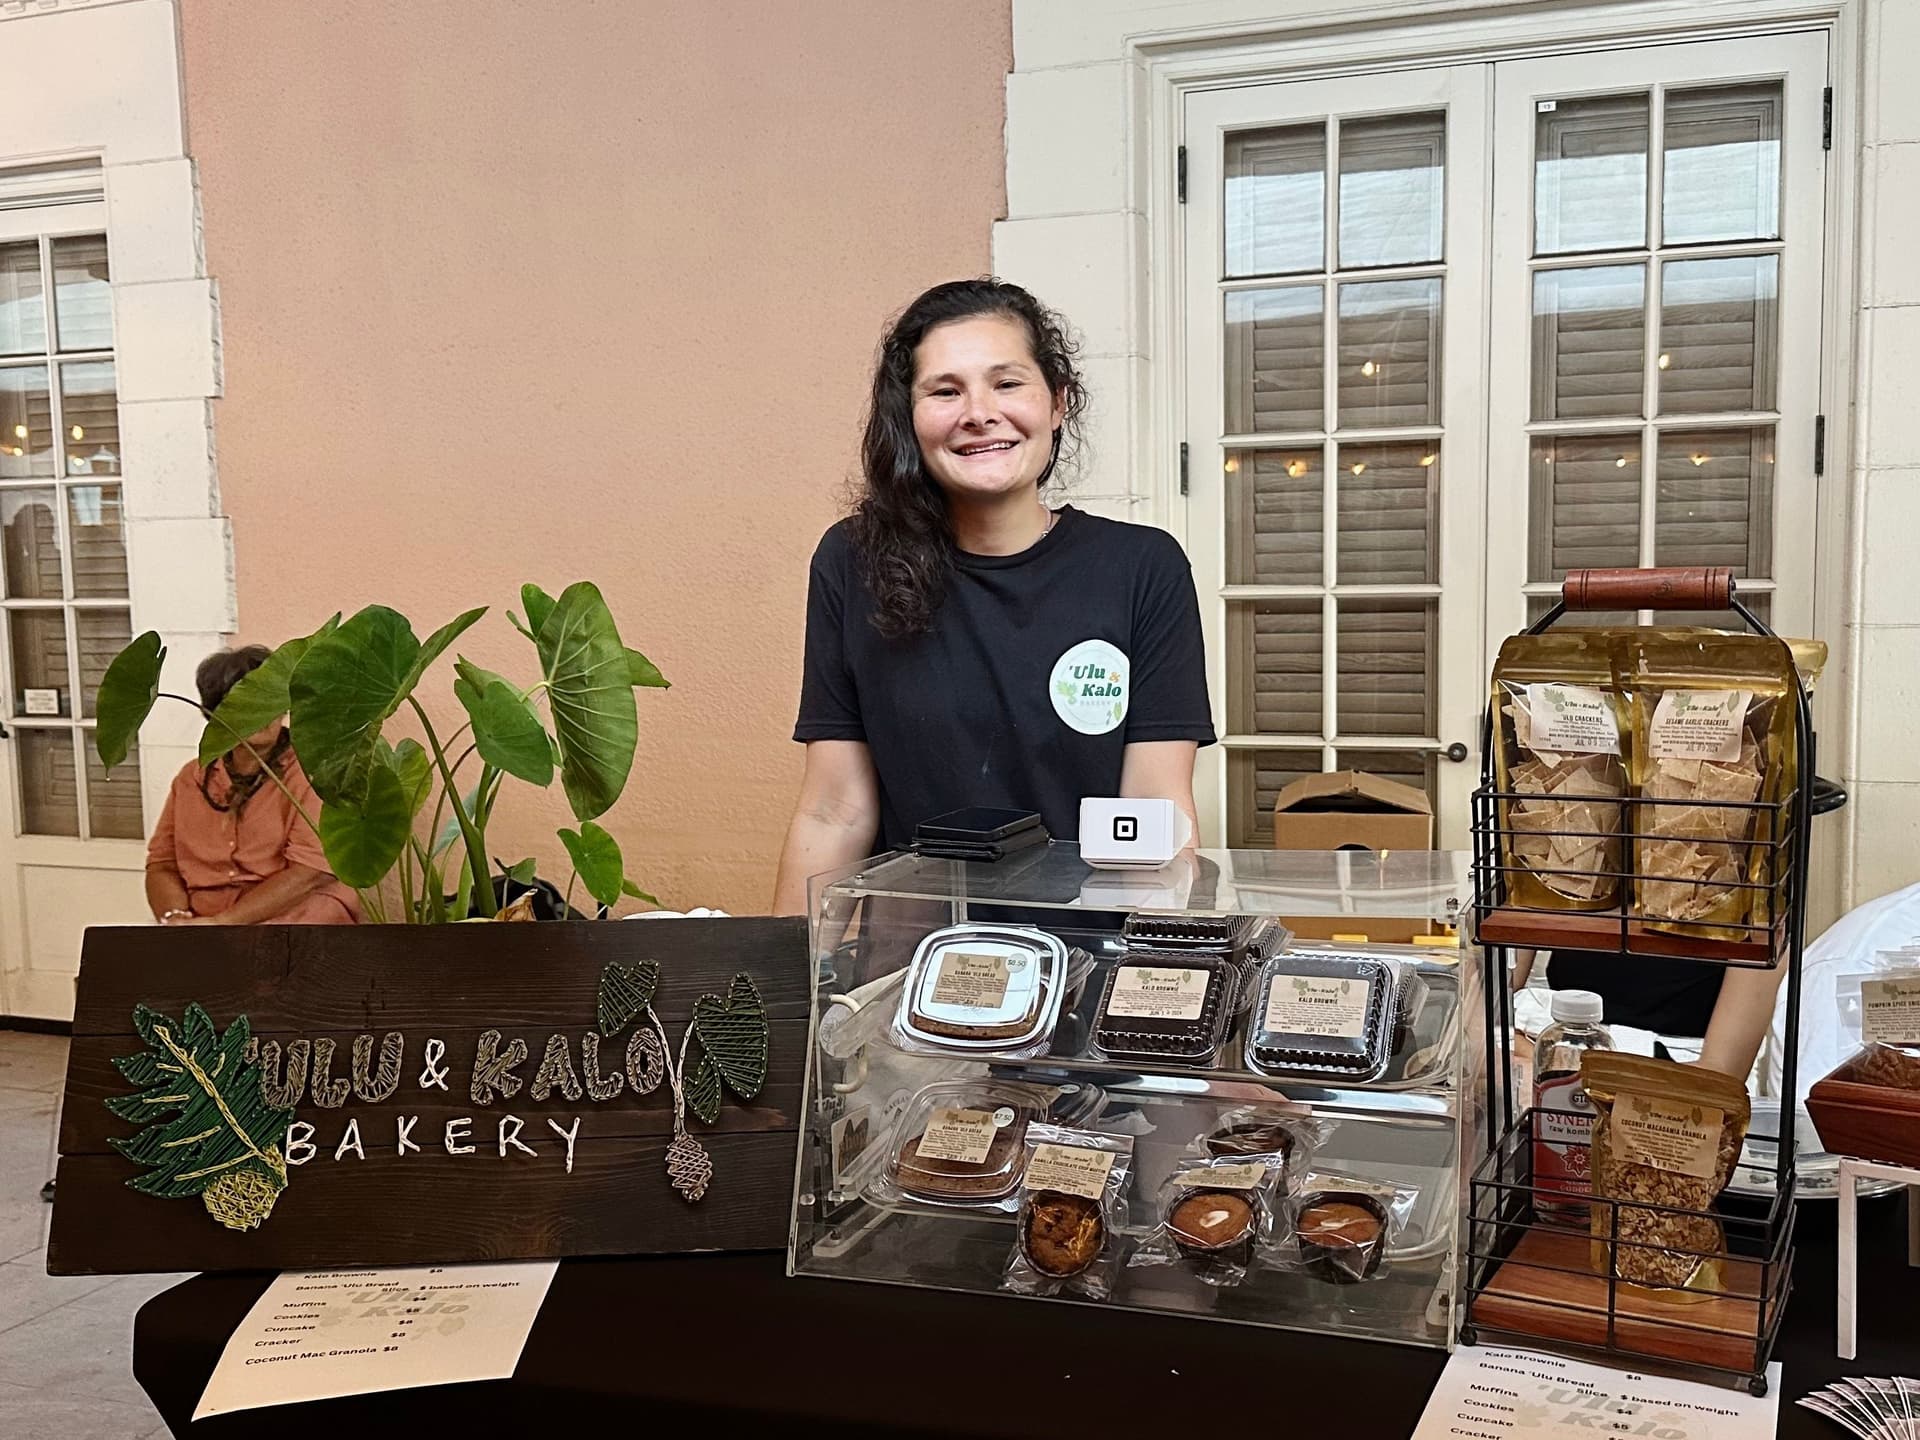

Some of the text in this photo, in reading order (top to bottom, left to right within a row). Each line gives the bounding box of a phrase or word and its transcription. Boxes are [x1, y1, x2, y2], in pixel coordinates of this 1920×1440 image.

[1109, 672, 1120, 683] &
[1081, 683, 1121, 697] Kalo
[1574, 715, 1603, 723] CRACKERS
[1702, 719, 1729, 727] CRACKERS
[419, 1038, 450, 1091] &
[470, 1027, 664, 1105] KALO
[994, 1113, 1013, 1121] $7.50
[1549, 1125, 1564, 1133] raw
[1621, 1119, 1707, 1140] COCONUT MACADAMIA GRANOLA
[286, 1114, 581, 1174] BAKERY
[273, 1313, 320, 1321] Cookies
[264, 1324, 316, 1333] Cupcake
[254, 1338, 304, 1347] Cracker
[245, 1345, 399, 1366] Coconut Mac Granola $8
[1485, 1350, 1512, 1359] Kalo
[1515, 1354, 1567, 1368] Brownie
[1479, 1362, 1526, 1375] Banana
[1556, 1376, 1595, 1389] Bread
[1470, 1383, 1633, 1416] Muffins $4
[1631, 1395, 1672, 1407] based
[1694, 1405, 1740, 1417] weight
[1457, 1412, 1514, 1427] Cupcake
[1463, 1398, 1629, 1431] Cookies $5
[1450, 1427, 1502, 1440] Cracker
